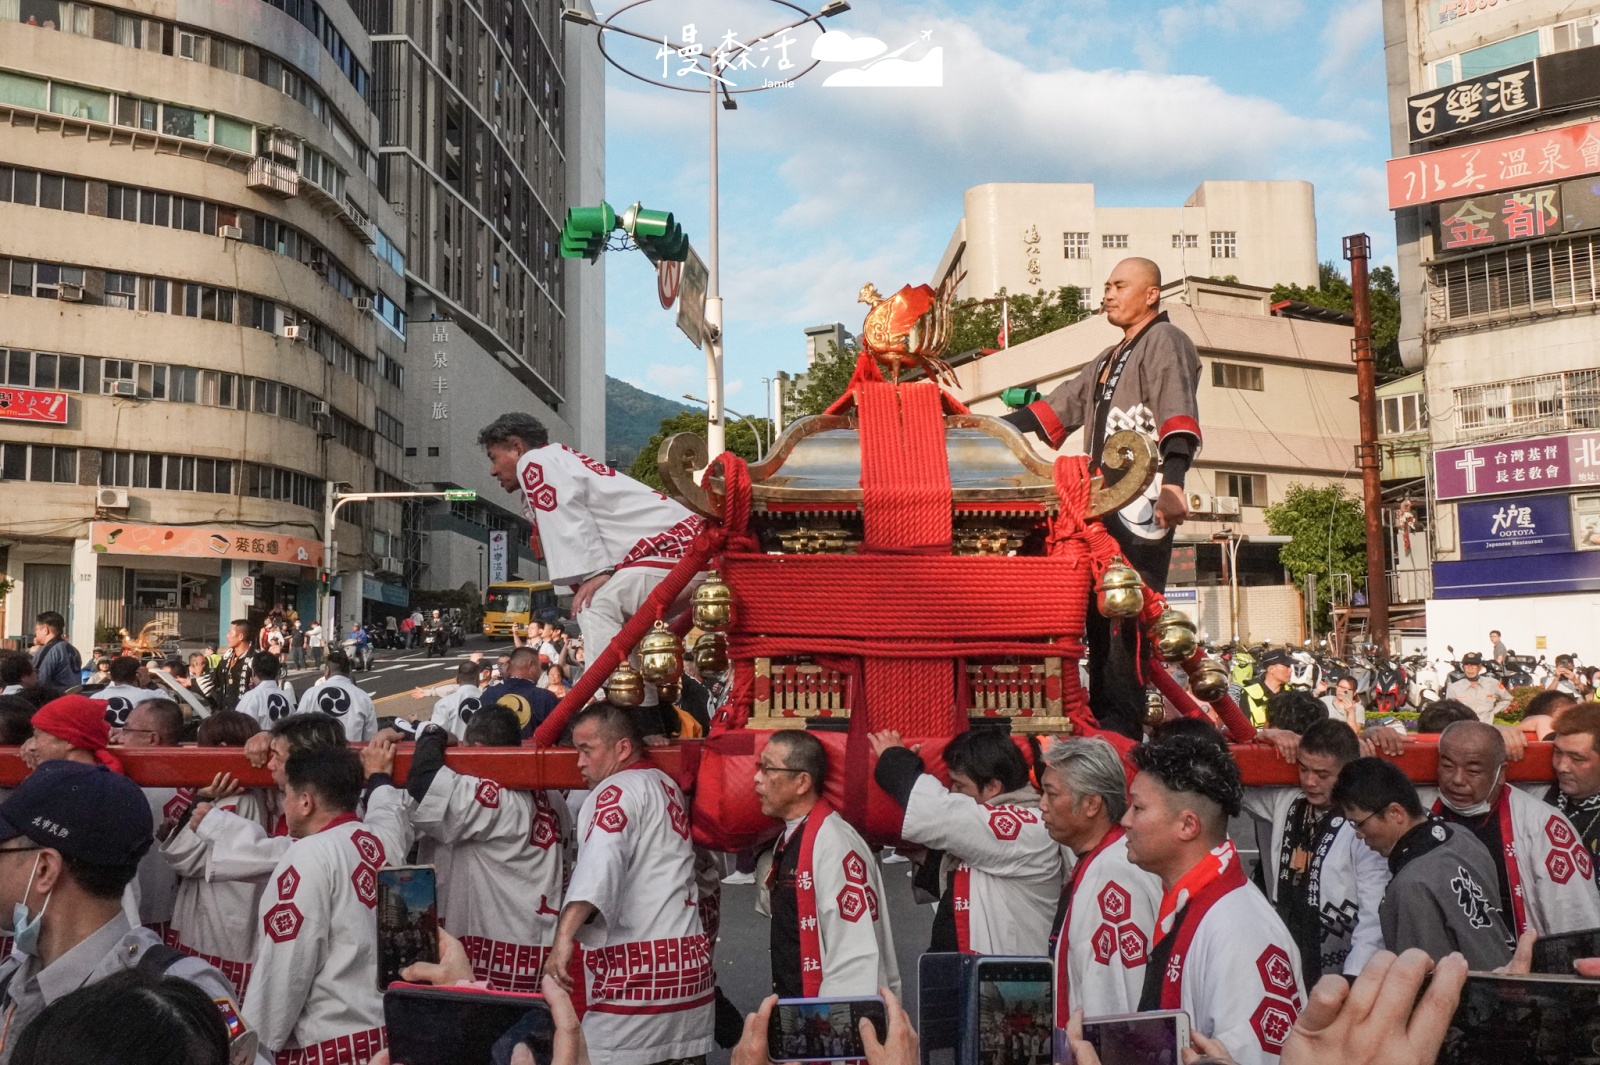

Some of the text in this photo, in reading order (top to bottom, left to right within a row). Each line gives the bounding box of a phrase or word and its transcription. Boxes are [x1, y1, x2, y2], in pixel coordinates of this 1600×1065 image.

[1442, 188, 1559, 249] 金都
[431, 325, 449, 420] 晶泉丰旅
[1494, 445, 1558, 465] 台灣基督
[1495, 464, 1559, 483] 長老教會
[1486, 538, 1544, 549] Japanese Restaurant
[1499, 529, 1535, 538] OOTOYA
[798, 870, 821, 972] 湯神社
